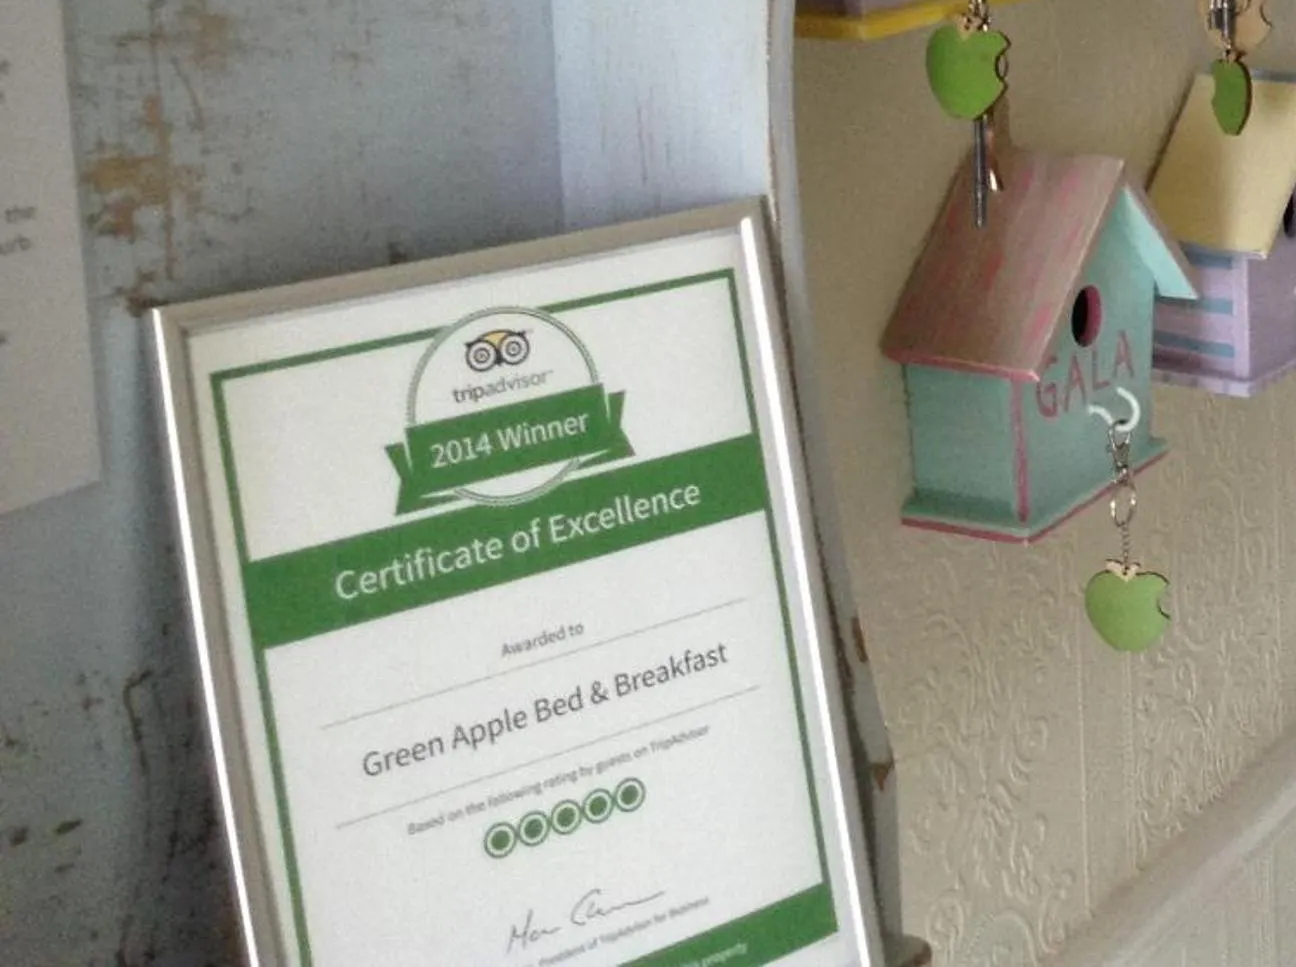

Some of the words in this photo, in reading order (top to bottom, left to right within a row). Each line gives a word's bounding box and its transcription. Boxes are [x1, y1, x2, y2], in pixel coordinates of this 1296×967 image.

[452, 371, 548, 403] tripadvisor
[1036, 329, 1135, 418] GALA
[430, 433, 493, 468] 2014
[497, 413, 588, 451] Winner
[335, 537, 503, 599] Certificate
[511, 517, 541, 553] of
[549, 484, 701, 544] Excellence
[501, 624, 566, 658] Awarded
[568, 623, 584, 637] to
[363, 736, 445, 776] Green
[451, 707, 528, 751] Apple
[534, 685, 584, 723] Bed
[590, 680, 610, 705] &
[614, 643, 729, 698] Breakfast
[407, 815, 445, 836] Based
[447, 809, 464, 822] on
[465, 801, 486, 816] the
[633, 746, 649, 758] on
